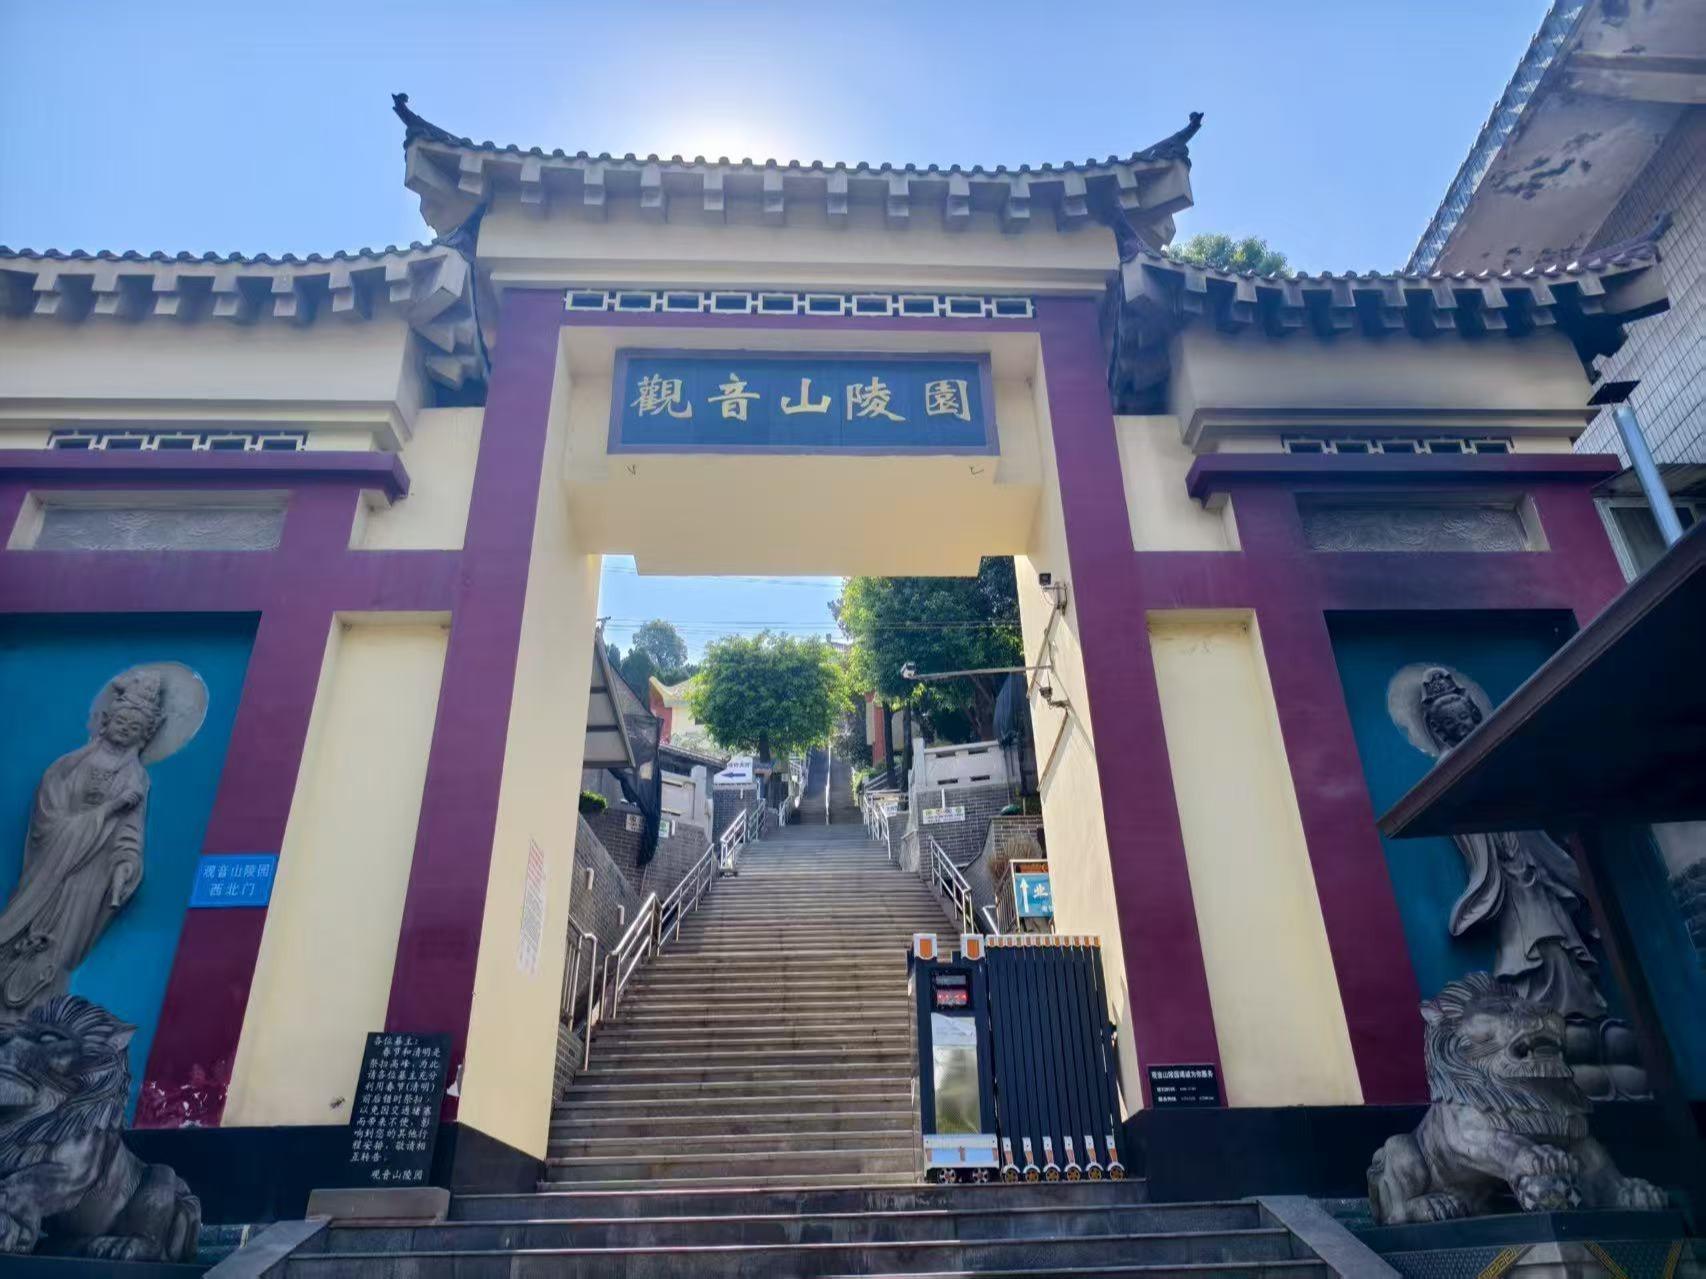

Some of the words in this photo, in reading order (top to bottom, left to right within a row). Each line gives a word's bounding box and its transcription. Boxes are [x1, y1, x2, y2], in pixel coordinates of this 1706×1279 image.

[630, 373, 971, 422] 觀音山陵園
[202, 864, 270, 878] 观音山陵园
[209, 883, 255, 897] 西北门
[383, 1047, 440, 1057] 春节和清明是
[367, 1070, 437, 1080] 请各位墓主充分
[371, 1169, 423, 1180] 观音山陵园
